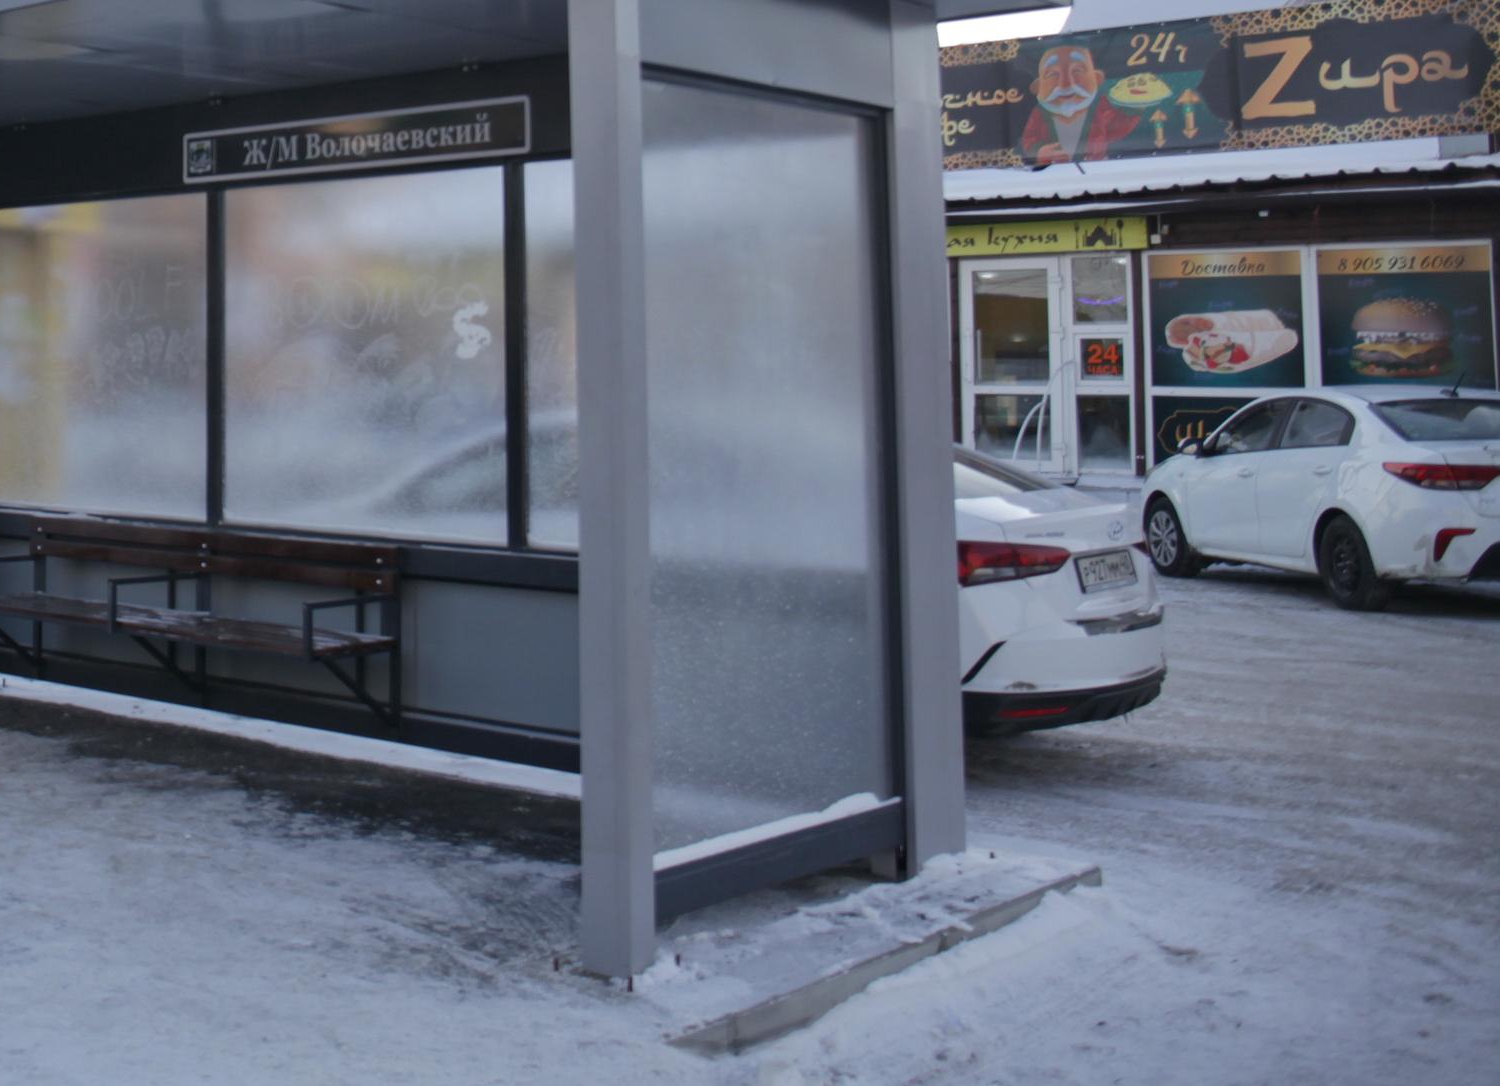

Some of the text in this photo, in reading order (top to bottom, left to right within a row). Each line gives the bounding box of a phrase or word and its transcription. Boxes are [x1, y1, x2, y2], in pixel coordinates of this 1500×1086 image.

[242, 113, 491, 170] Ж/М Волочаевский
[1180, 255, 1268, 277] Доставка
[1337, 254, 1466, 272] 8 905 931 6069
[1086, 343, 1119, 364] 24
